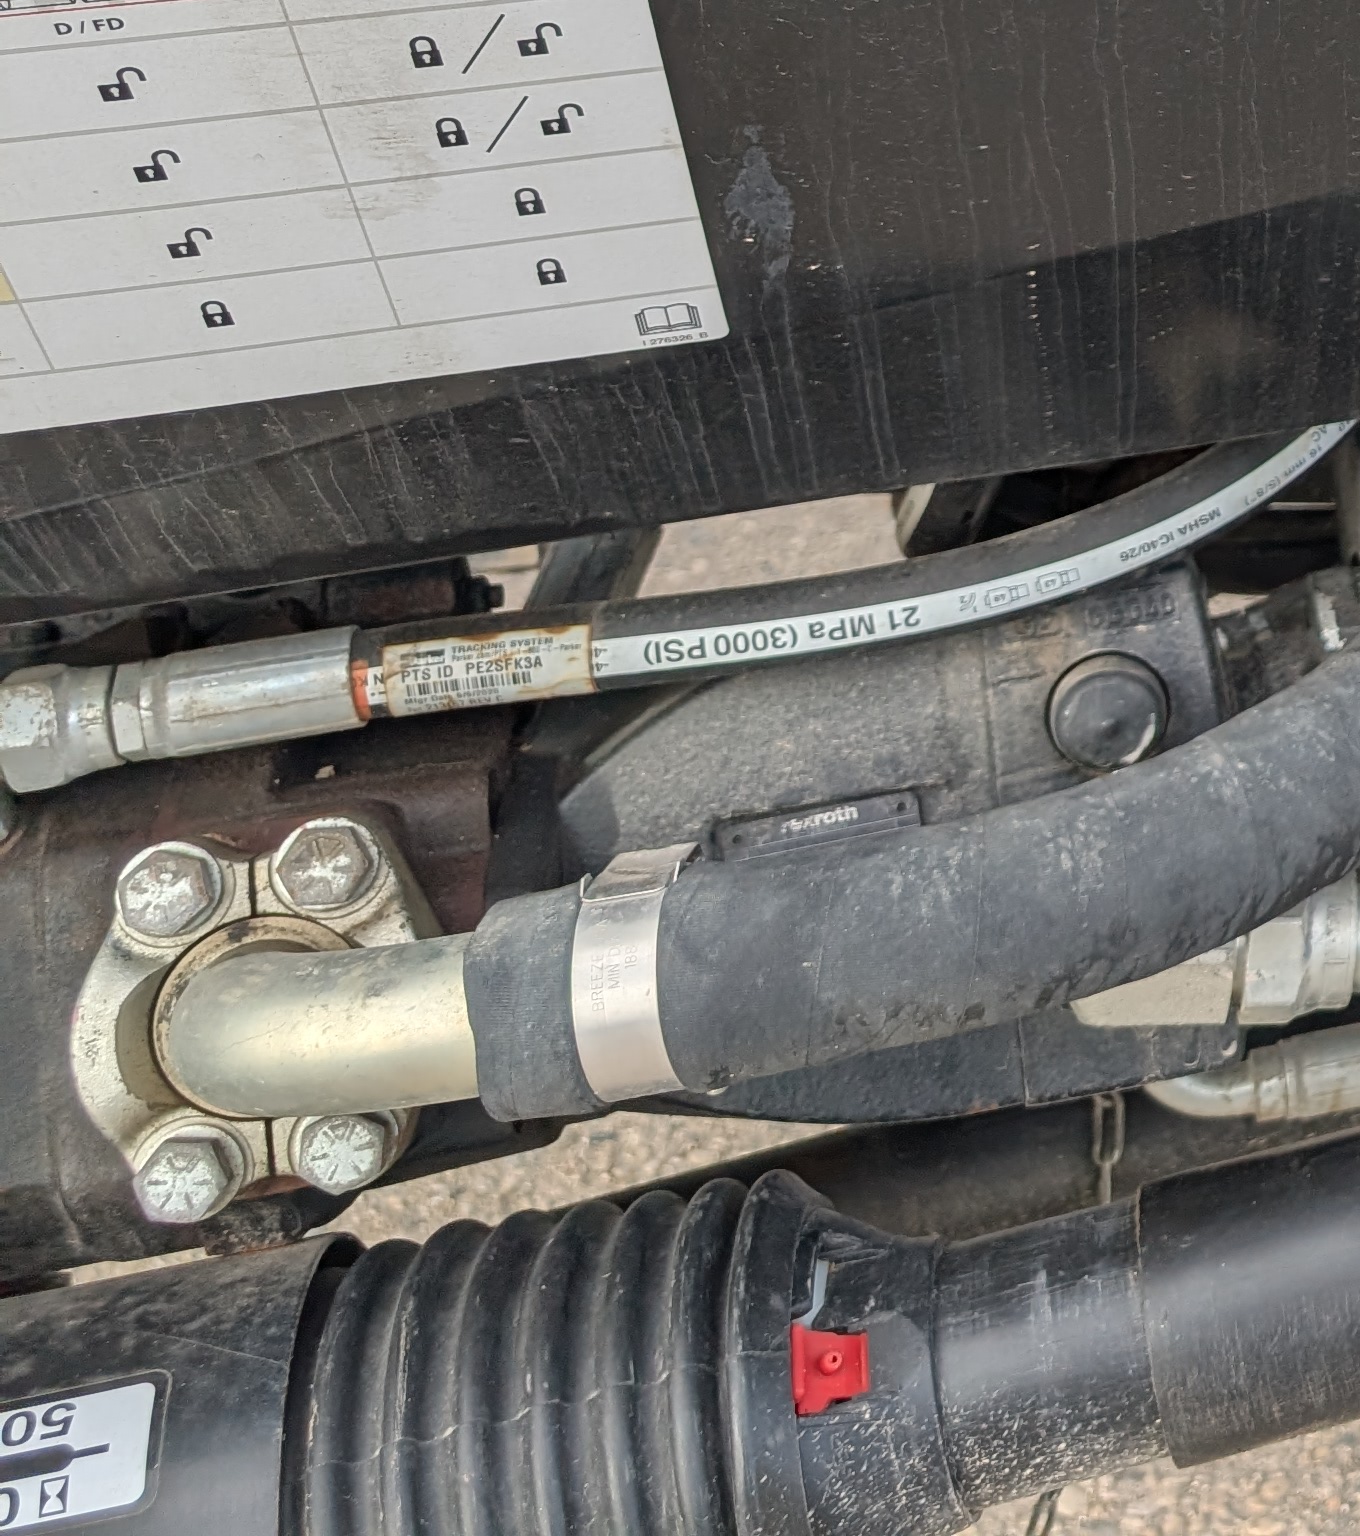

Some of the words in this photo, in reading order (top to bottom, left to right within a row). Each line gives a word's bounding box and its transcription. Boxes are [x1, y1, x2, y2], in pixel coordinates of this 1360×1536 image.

[53, 22, 73, 36] D
[92, 17, 125, 32] FD
[1175, 506, 1221, 537] MSHA
[1117, 529, 1175, 564] IC40/26
[807, 612, 876, 644] MPa
[886, 604, 920, 630] 21
[451, 640, 506, 655] TRACKING
[509, 636, 553, 648] SYSTEM
[642, 635, 707, 666] PSI)
[712, 622, 798, 657] (3000
[400, 667, 432, 682] PTS
[436, 664, 454, 678] ID
